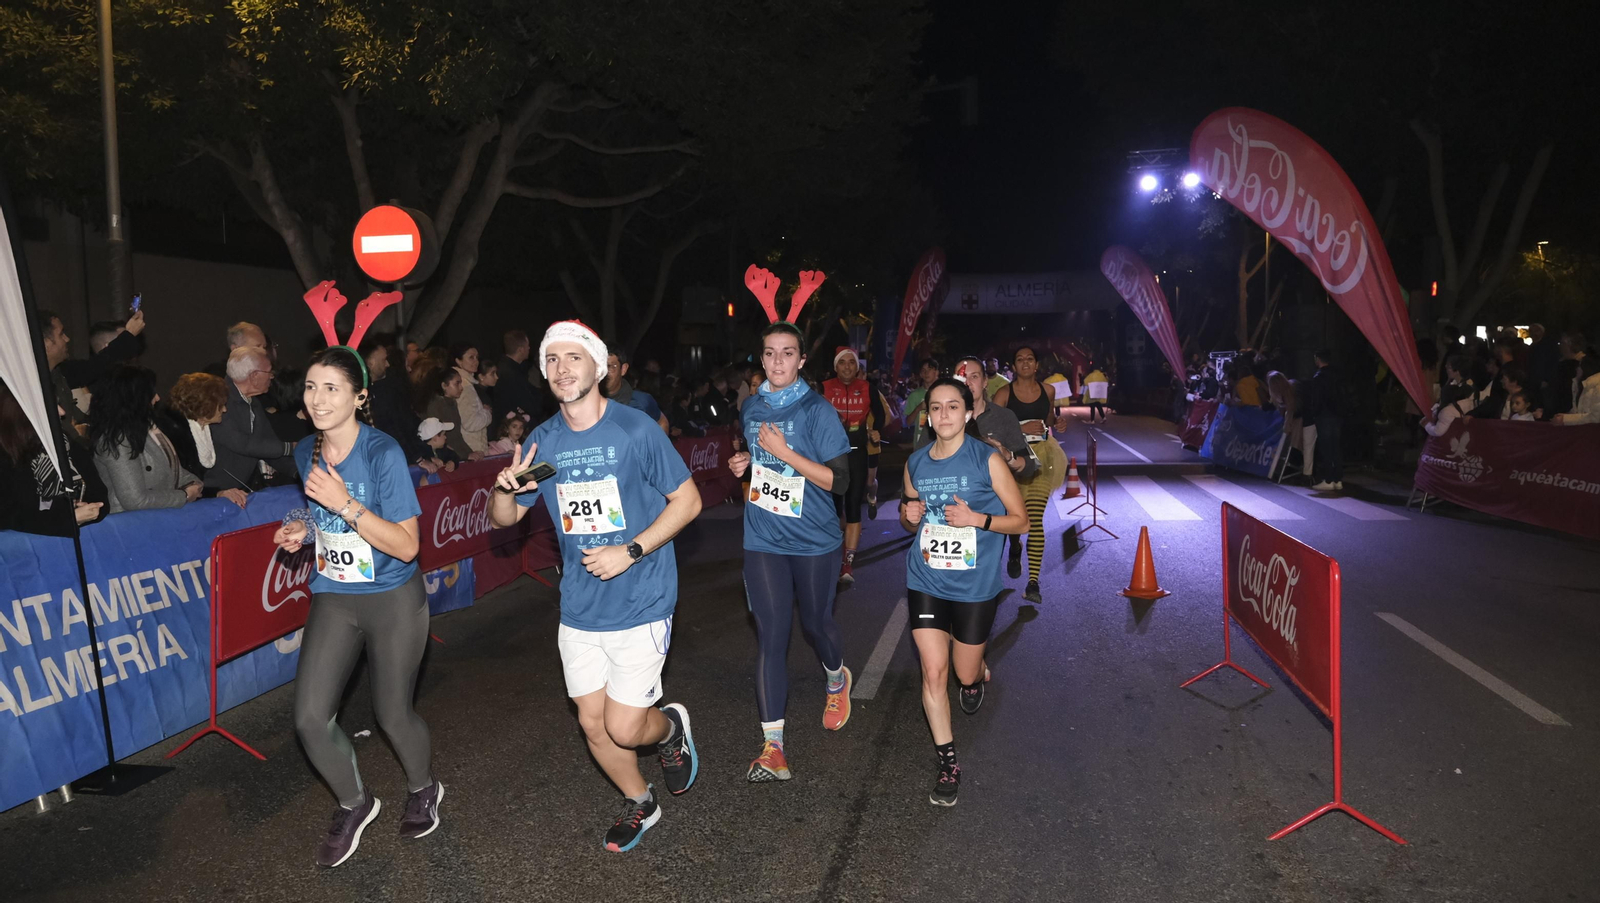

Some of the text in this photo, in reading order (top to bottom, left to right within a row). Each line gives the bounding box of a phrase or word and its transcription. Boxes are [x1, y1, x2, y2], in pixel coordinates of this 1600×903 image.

[904, 252, 942, 336] Coca-Cola
[995, 279, 1071, 298] ALMERÍA
[995, 299, 1034, 308] CIUDAD
[690, 442, 719, 473] Coca-Cola
[1225, 435, 1273, 466] deporte
[762, 482, 790, 502] 845
[569, 499, 602, 516] 281
[323, 547, 354, 565] 280
[930, 539, 962, 554] 212
[1238, 534, 1300, 645] Coca-Cola
